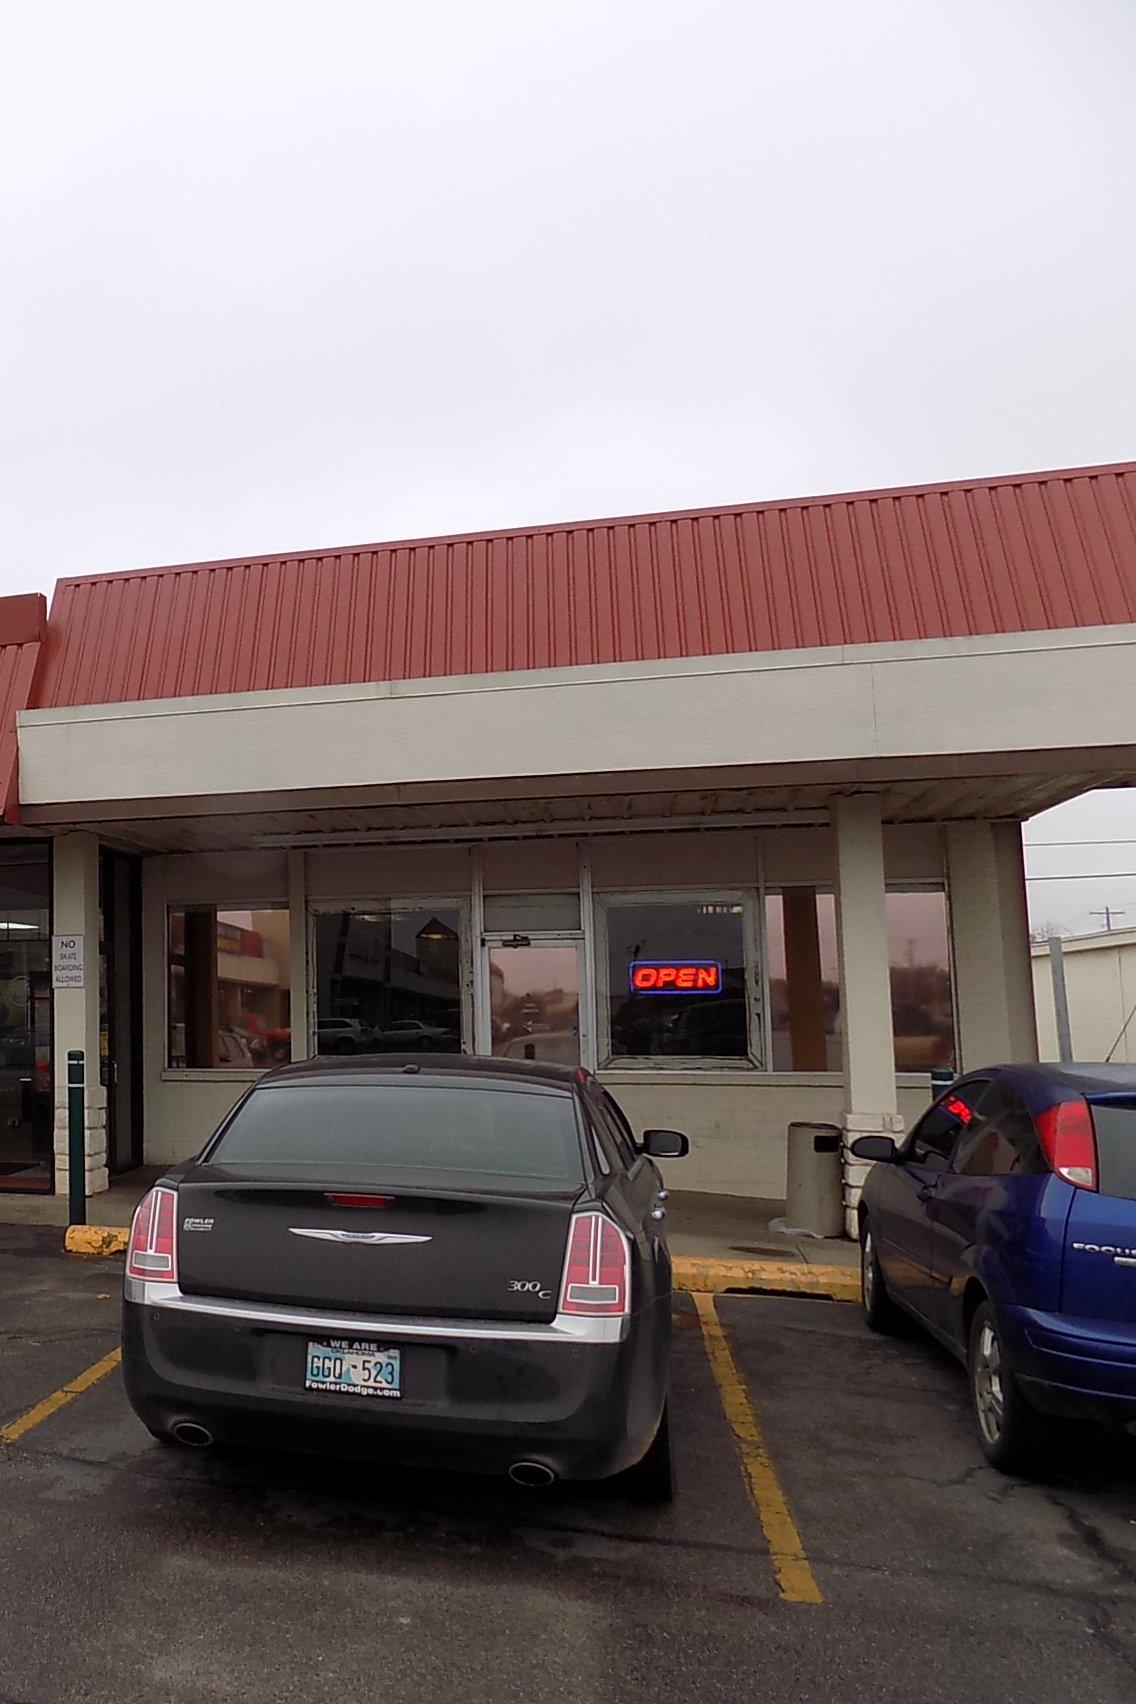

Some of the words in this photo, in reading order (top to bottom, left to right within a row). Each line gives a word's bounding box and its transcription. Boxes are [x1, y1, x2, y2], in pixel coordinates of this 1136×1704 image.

[60, 939, 76, 949] NO
[59, 952, 77, 960] SKATE
[54, 964, 83, 972] BOARDING
[55, 975, 83, 983] ALLOWED
[635, 966, 717, 988] OPEN
[330, 1340, 349, 1349] WE
[352, 1342, 378, 1351] ARE
[305, 1380, 401, 1397] FowlerDodge.com
